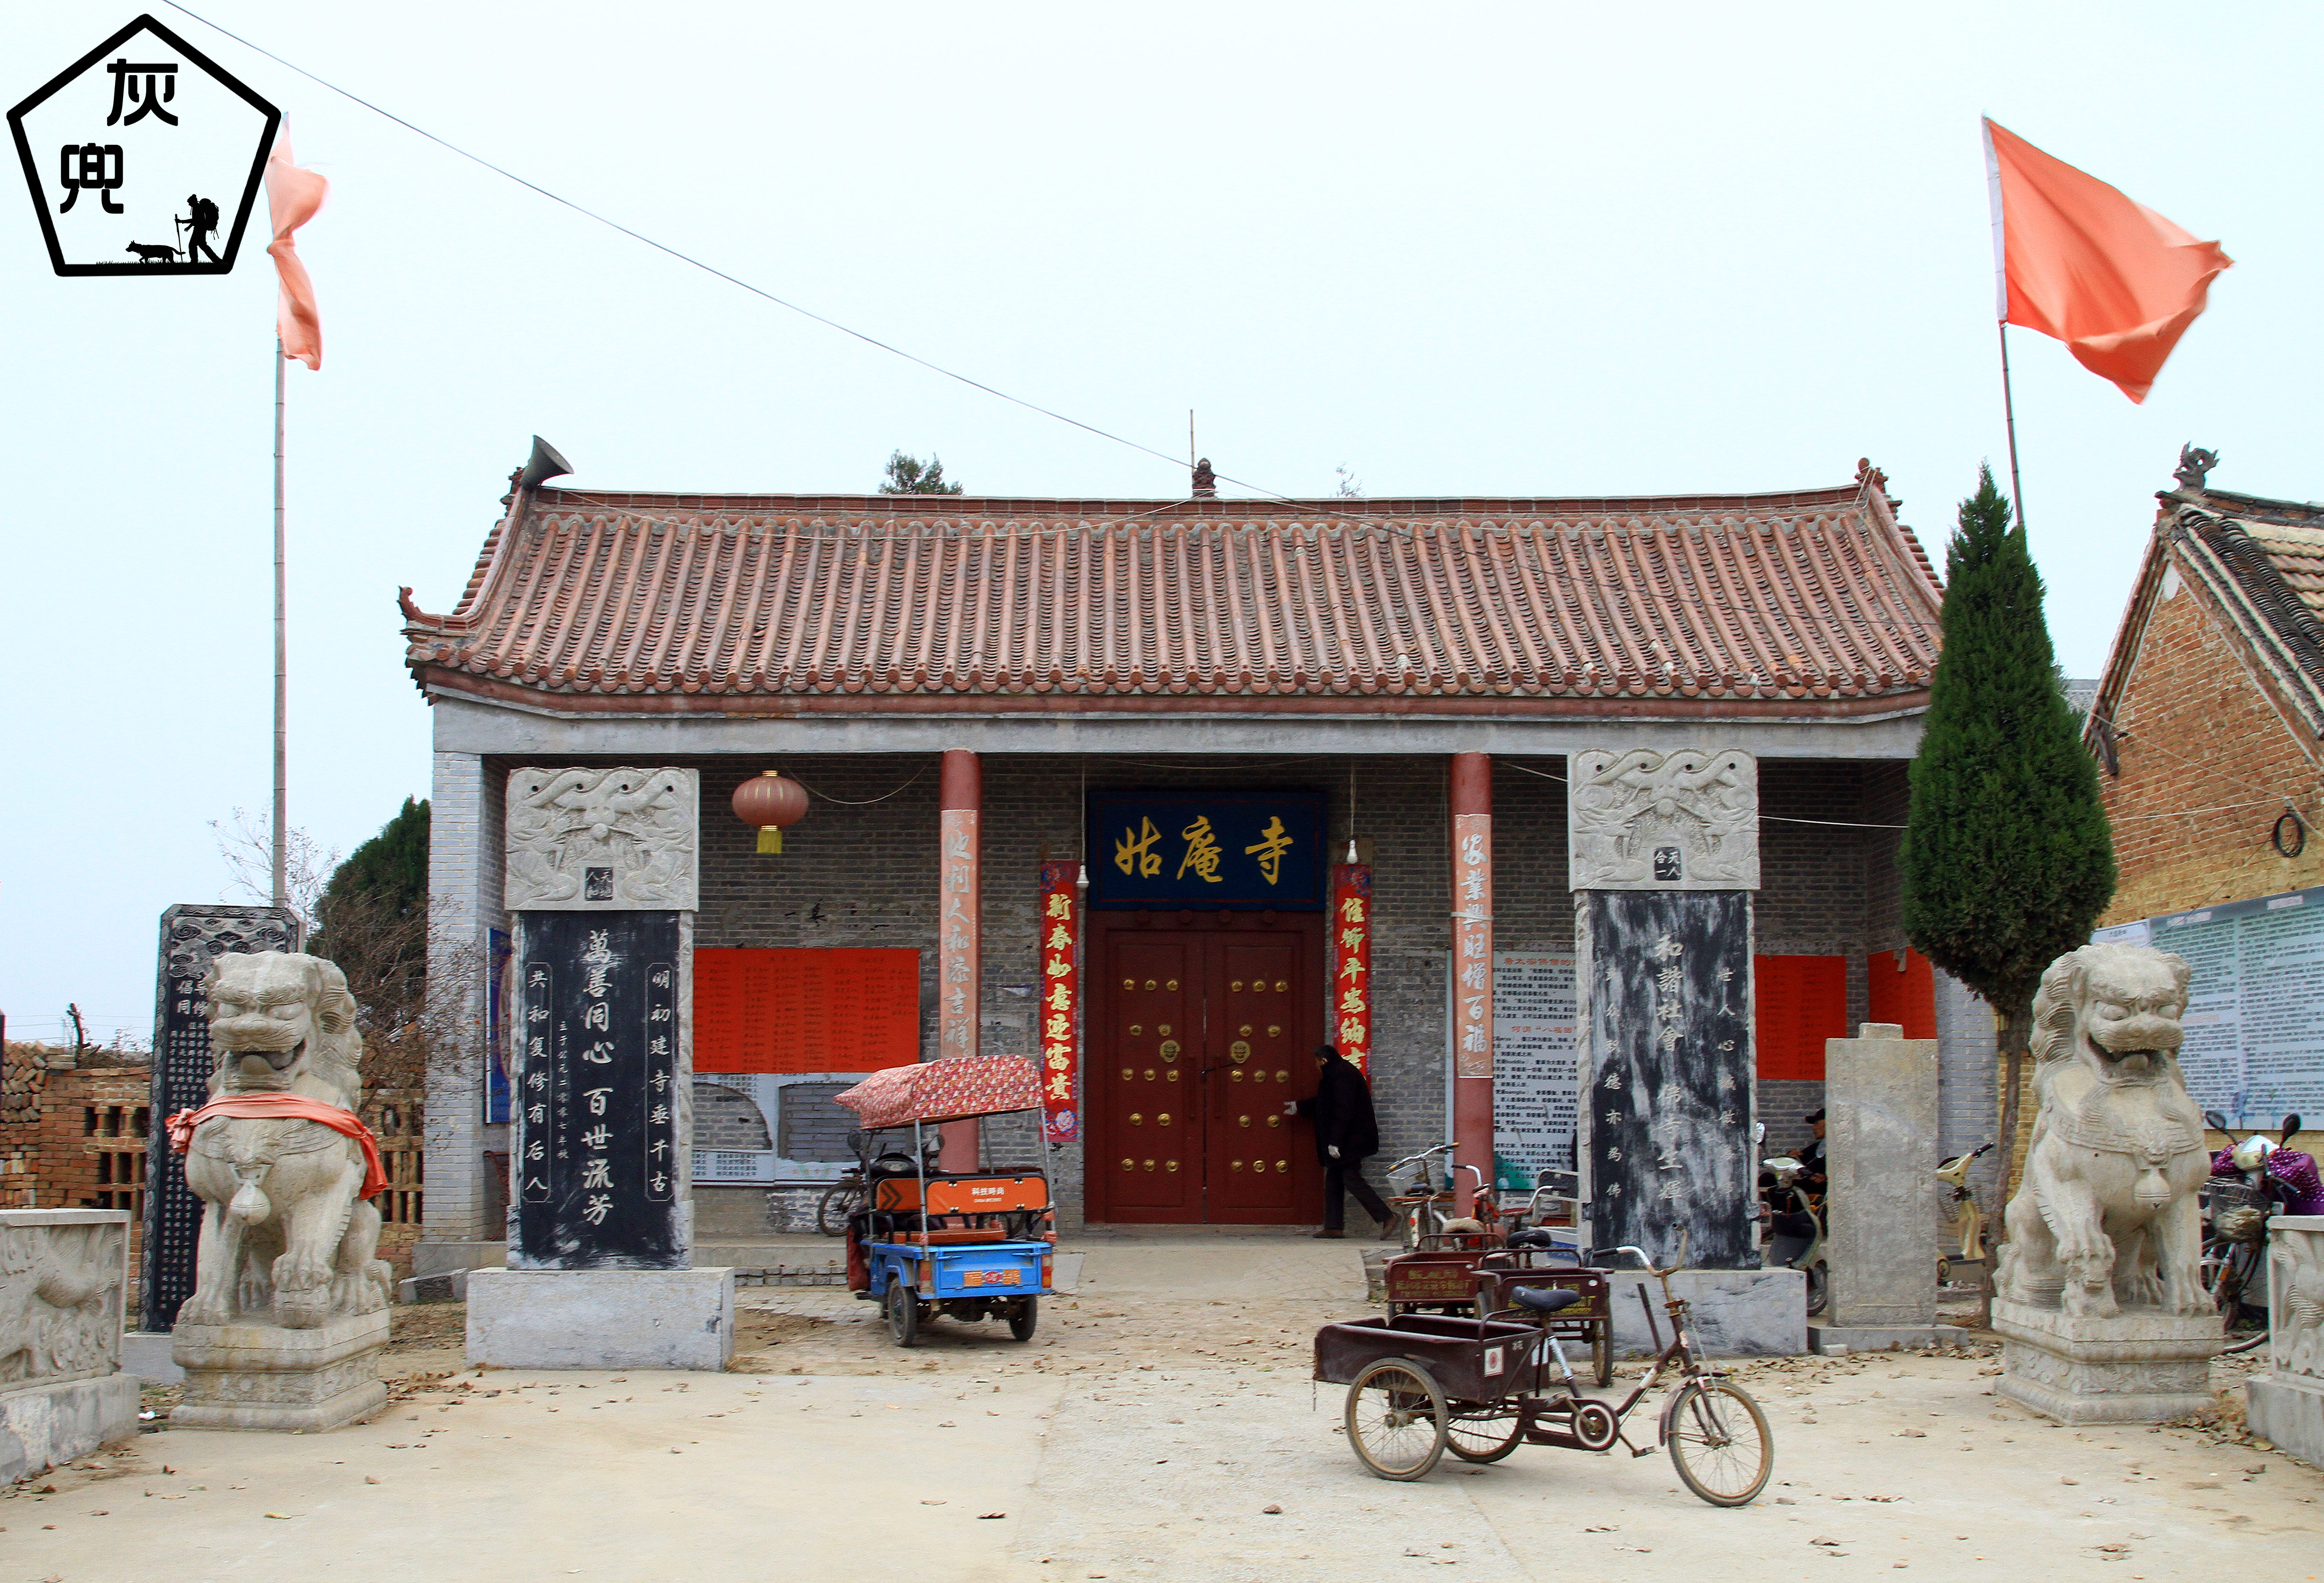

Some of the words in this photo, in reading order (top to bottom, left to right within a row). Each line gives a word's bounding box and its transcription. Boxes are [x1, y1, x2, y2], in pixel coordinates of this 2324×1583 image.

[1115, 815, 1294, 885] 姑庵寺
[582, 928, 615, 1064] 萬善同心
[1339, 897, 1367, 1080] 佳節平安納吉
[1654, 933, 1684, 1052] 和諧社會
[525, 970, 550, 1191] 共和复修有后人
[648, 970, 672, 1192] 明初建寺垂千古
[581, 1087, 615, 1226] 百世流芳
